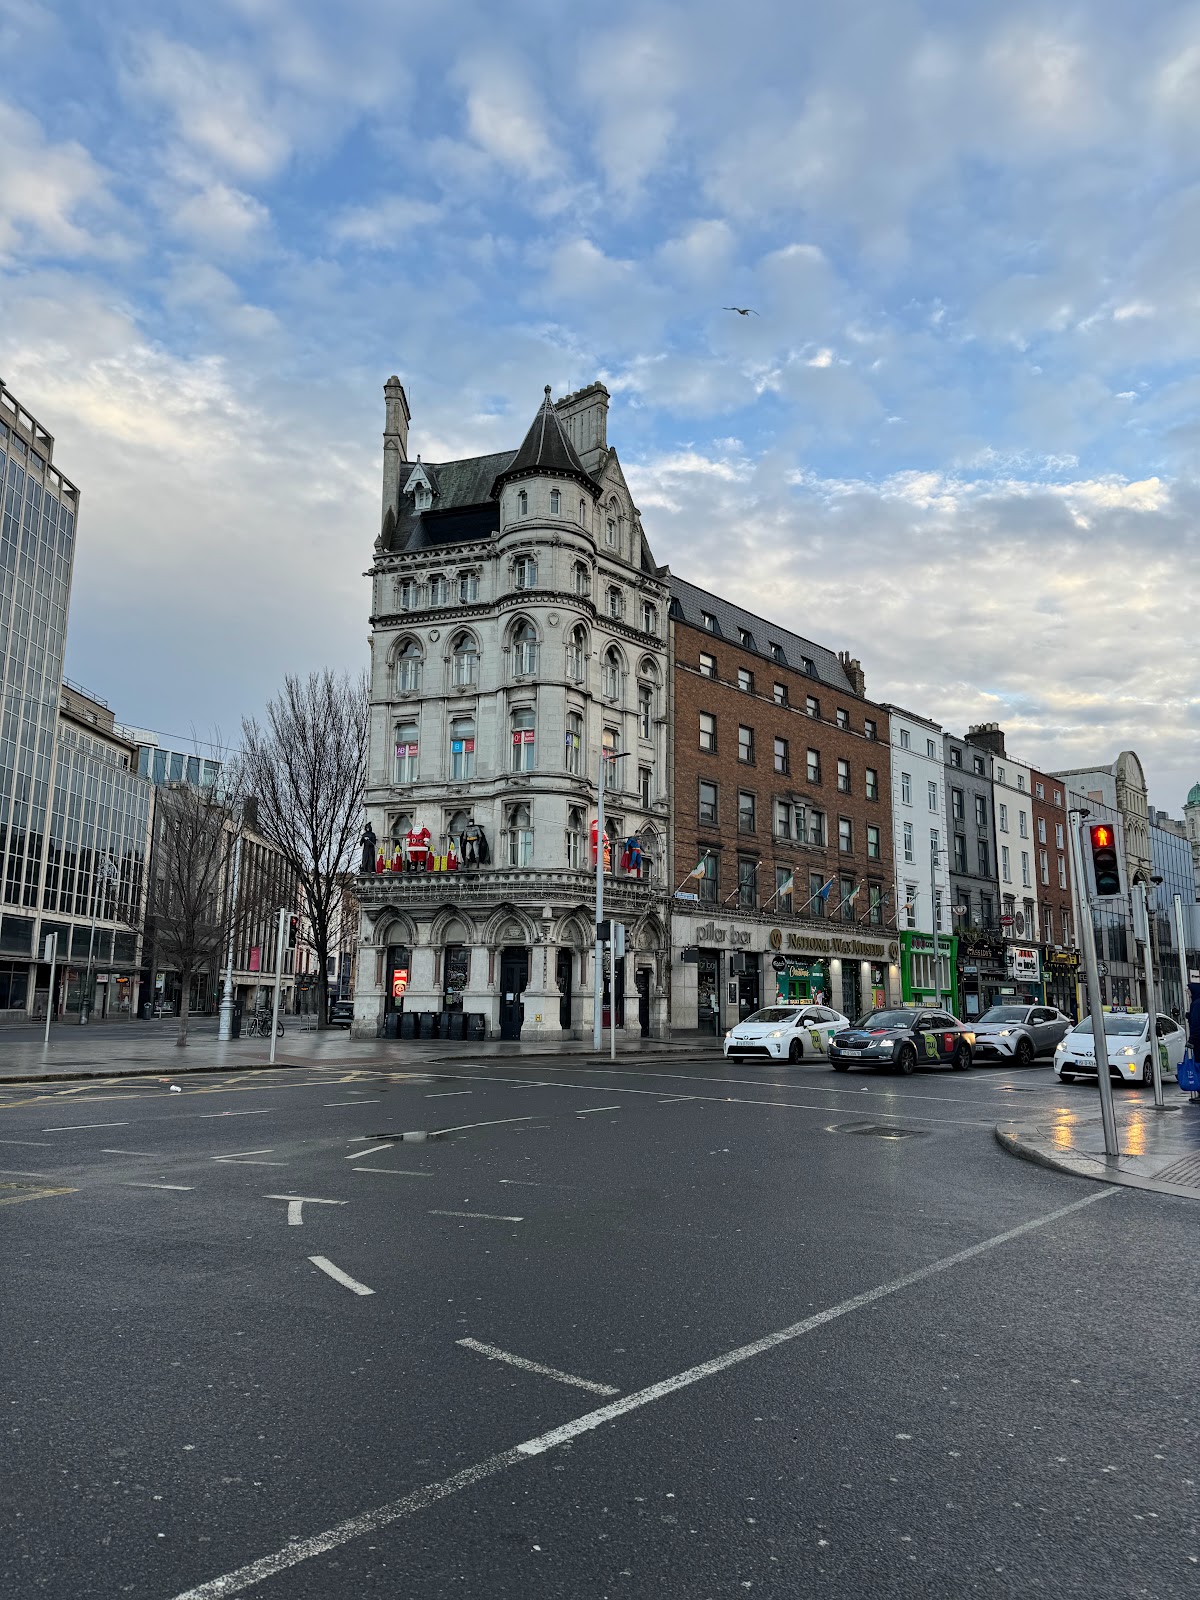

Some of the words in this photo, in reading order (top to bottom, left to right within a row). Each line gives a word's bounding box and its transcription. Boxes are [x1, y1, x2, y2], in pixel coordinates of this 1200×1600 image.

[696, 921, 728, 944] pillar
[730, 924, 752, 945] bar
[788, 932, 830, 953] NATIONAL
[832, 937, 852, 954] WAX
[853, 939, 885, 957] MUSEUM
